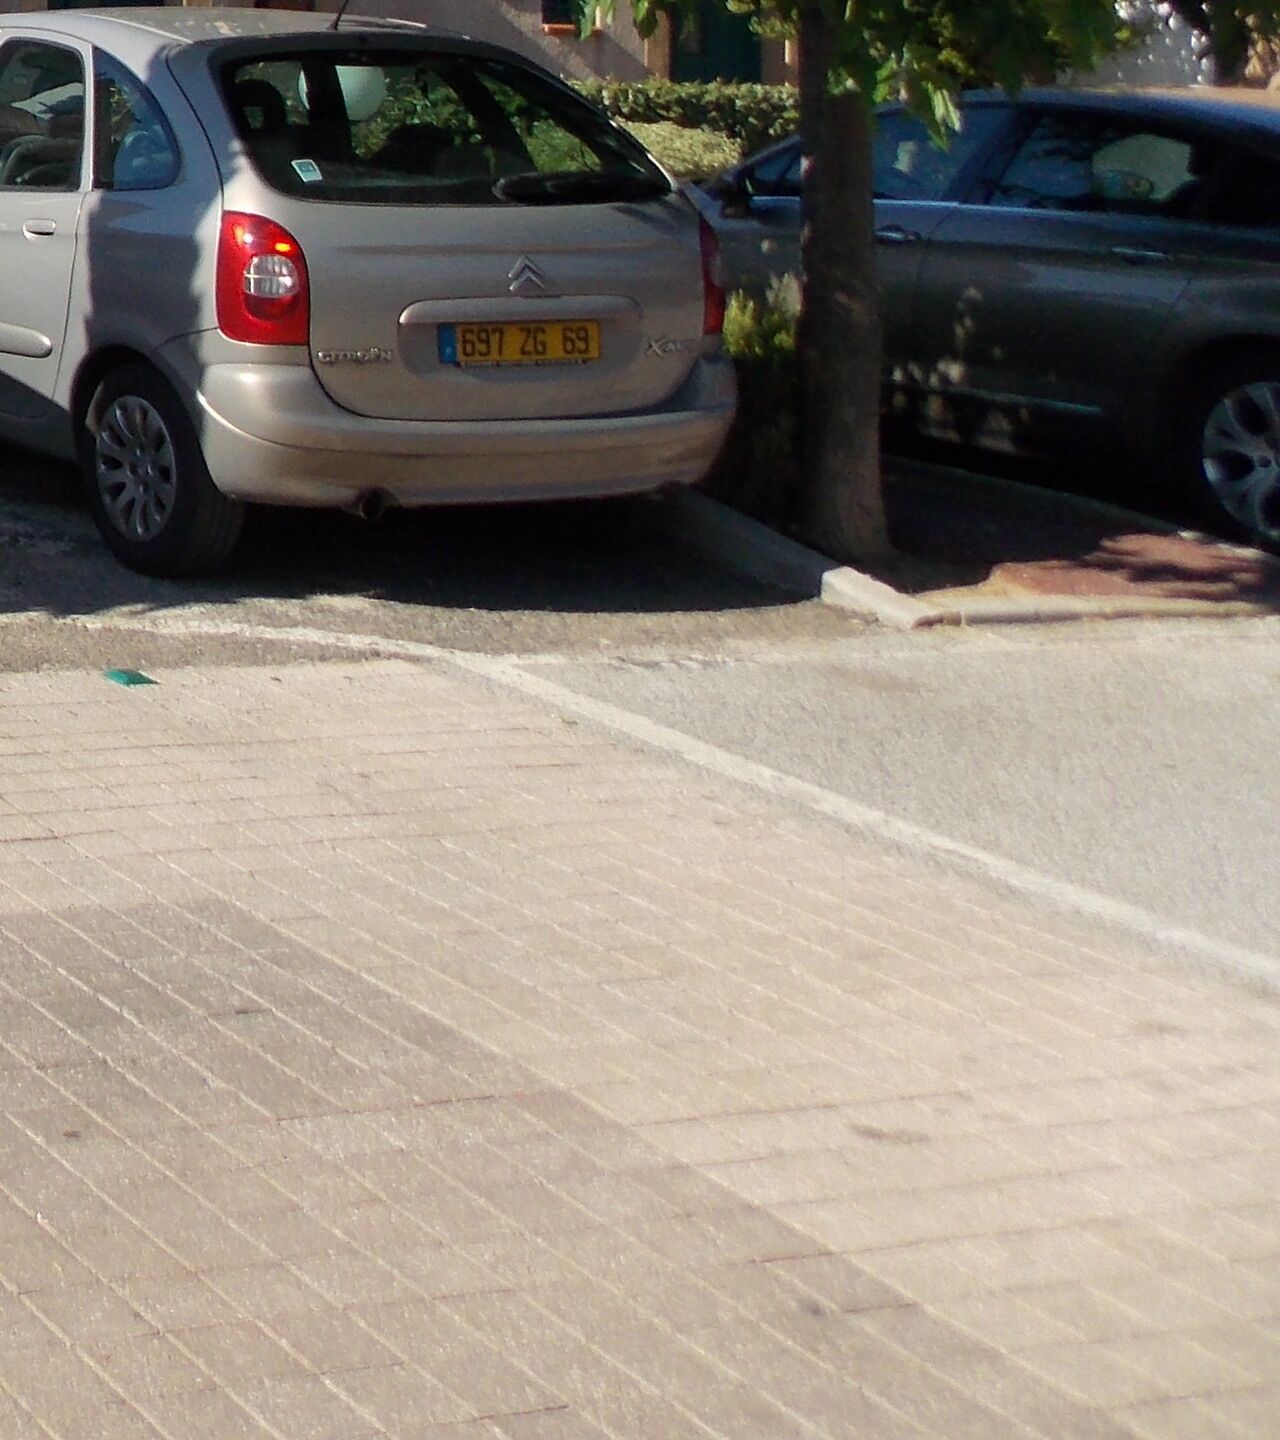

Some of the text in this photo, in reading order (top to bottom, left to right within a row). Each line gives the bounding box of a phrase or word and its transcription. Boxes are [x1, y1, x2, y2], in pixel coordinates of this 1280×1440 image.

[461, 325, 589, 357] 697 ZG 69
